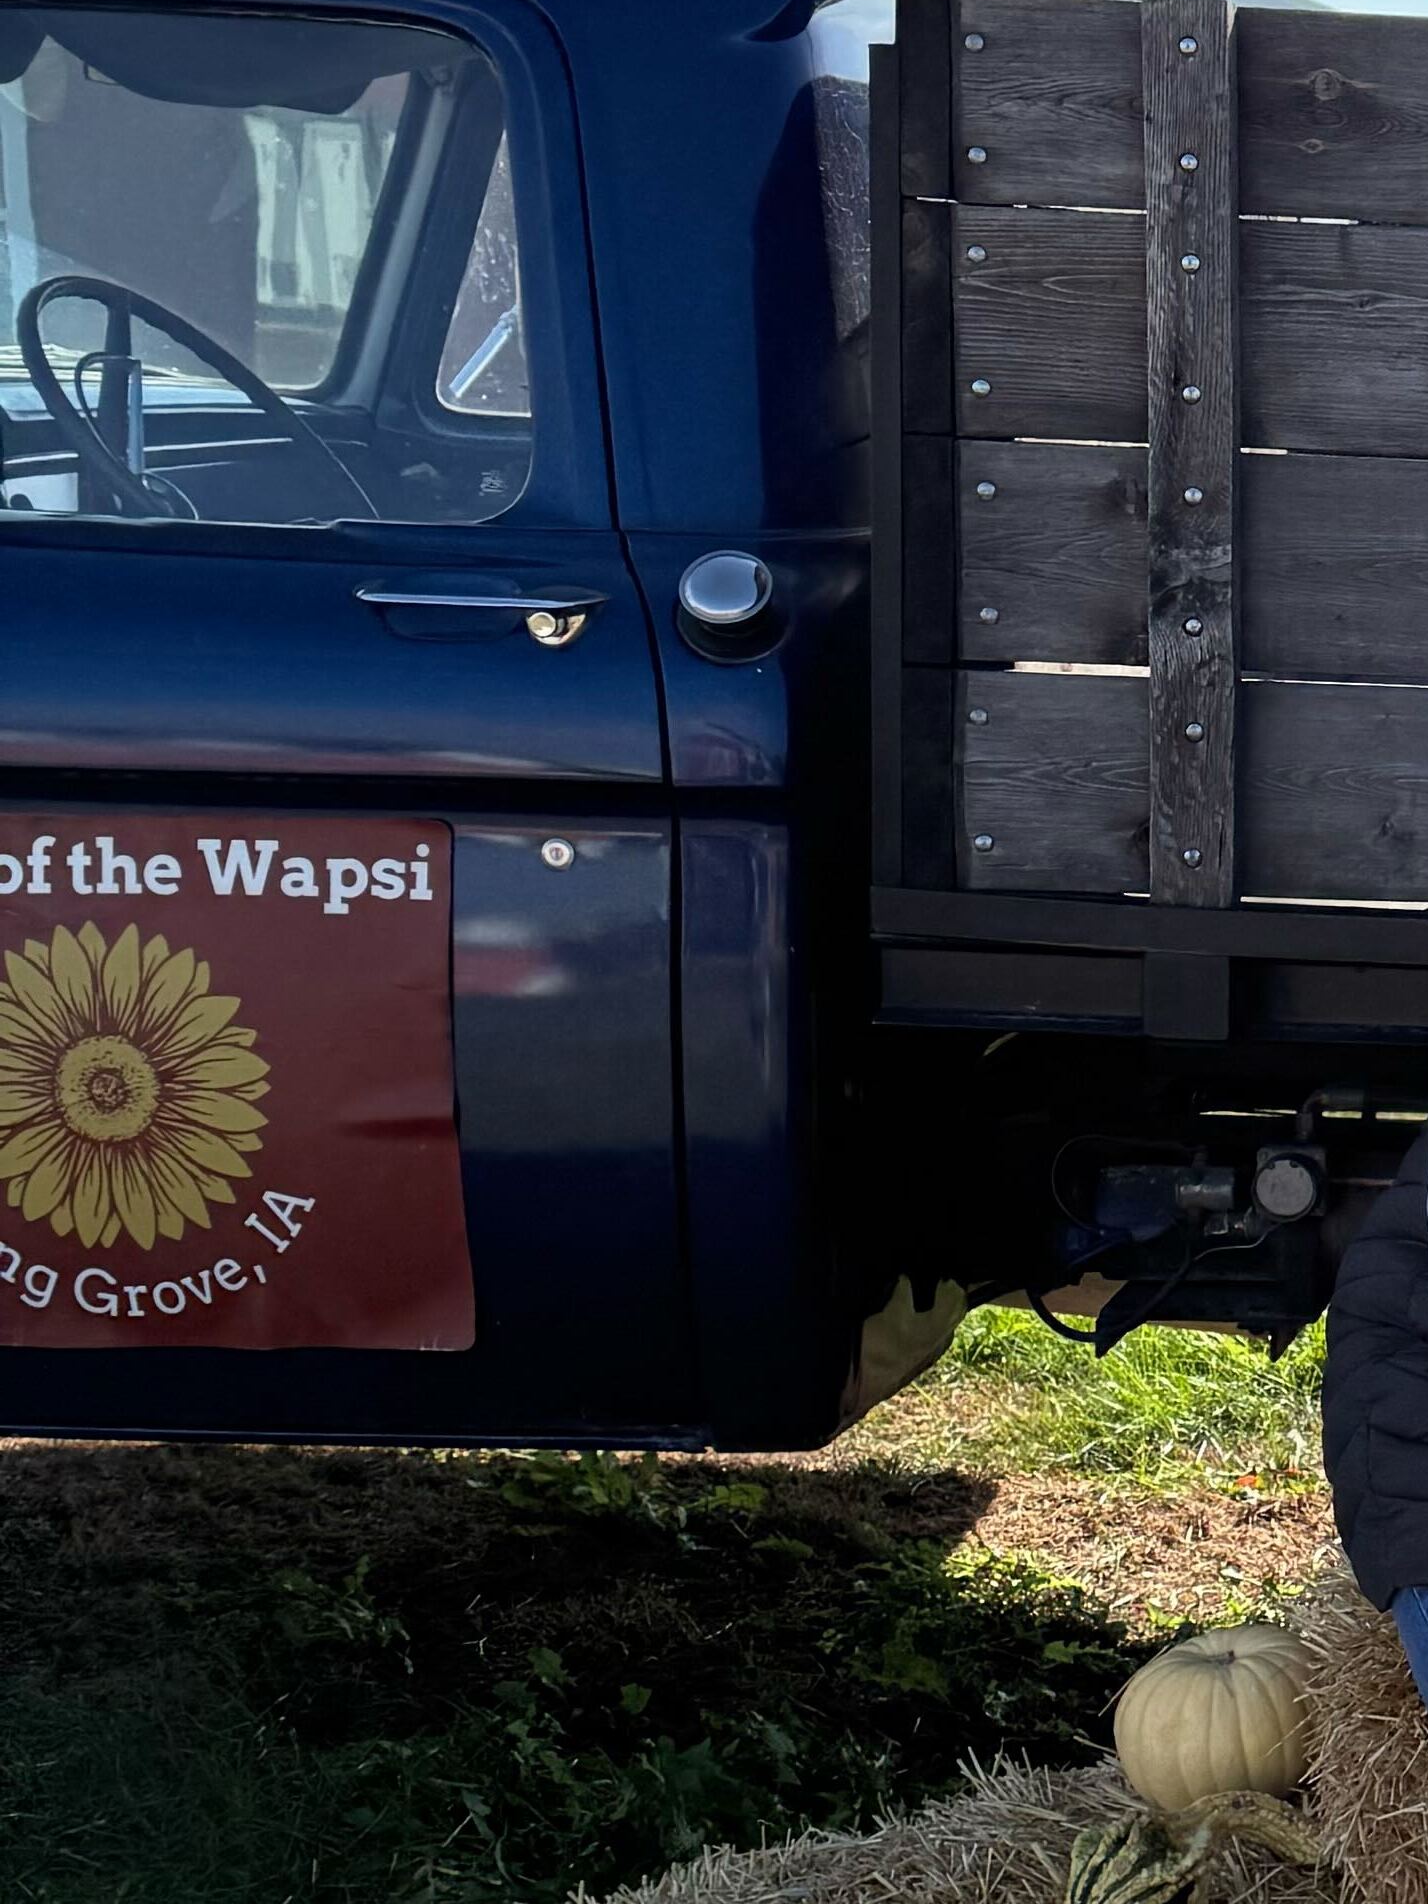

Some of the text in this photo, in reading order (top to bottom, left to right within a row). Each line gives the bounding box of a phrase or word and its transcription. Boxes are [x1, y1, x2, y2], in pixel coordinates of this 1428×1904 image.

[0, 835, 433, 915] of the Wapsi
[74, 1257, 267, 1318] Grove,
[244, 1190, 316, 1254] IA
